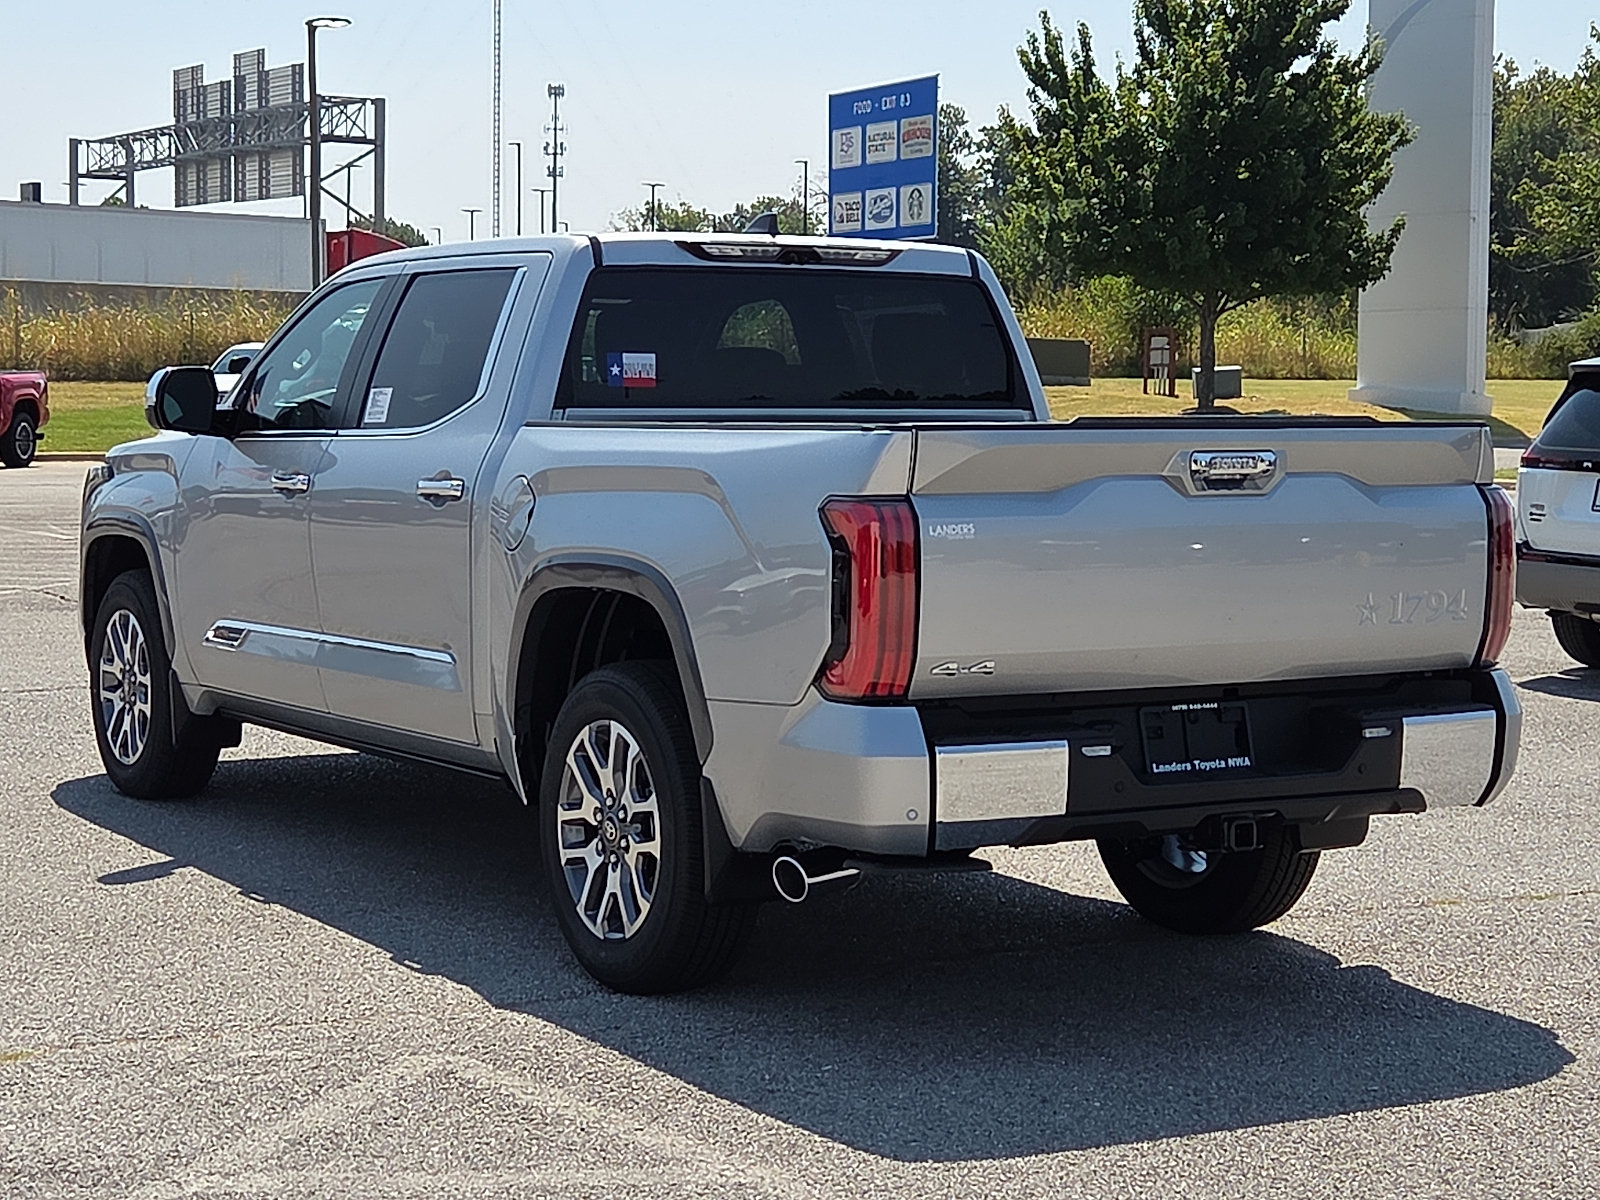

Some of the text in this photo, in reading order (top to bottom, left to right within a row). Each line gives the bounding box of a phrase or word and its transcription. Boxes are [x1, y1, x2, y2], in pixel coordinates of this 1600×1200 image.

[854, 100, 872, 115] FOOD
[882, 95, 896, 110] EXIT
[868, 132, 895, 142] NATURAL
[868, 143, 885, 154] STATE
[844, 201, 861, 212] TACO
[845, 212, 861, 224] BELL
[929, 523, 976, 537] LANDERS
[1388, 588, 1469, 625] 1794
[1152, 756, 1251, 773] Landers Toyota NWA
